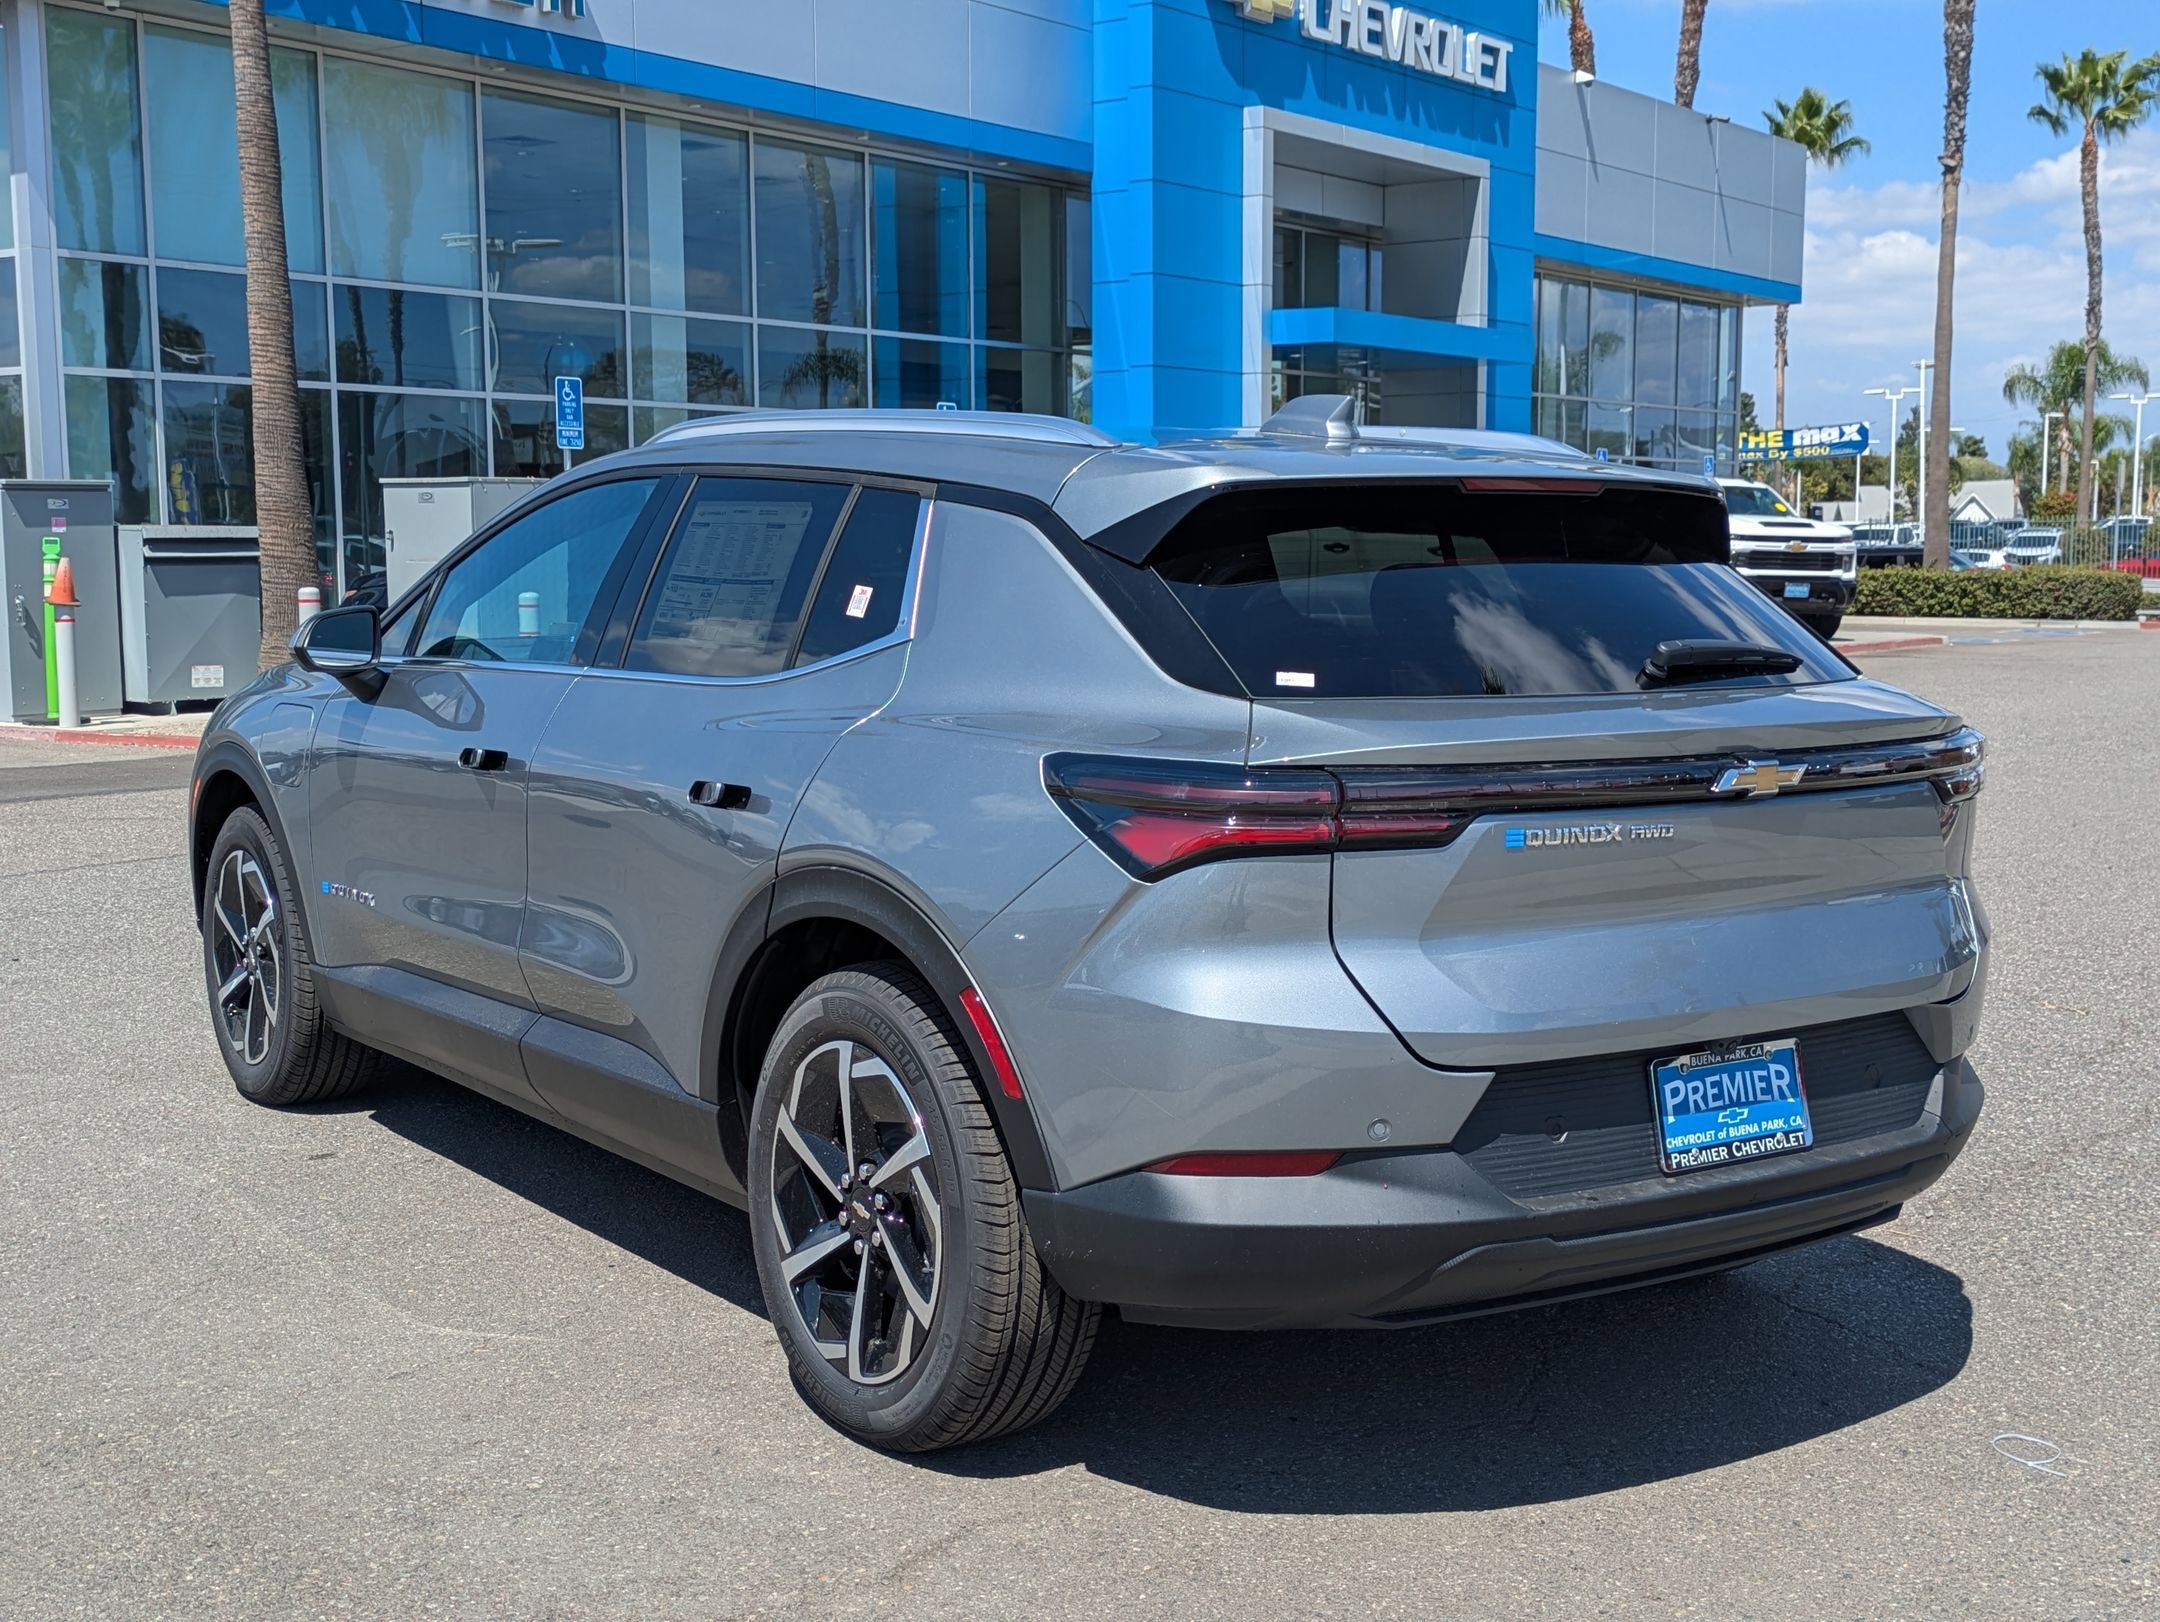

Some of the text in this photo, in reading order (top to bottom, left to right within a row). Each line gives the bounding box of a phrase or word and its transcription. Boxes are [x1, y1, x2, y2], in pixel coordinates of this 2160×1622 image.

[1300, 0, 1513, 92] CHEVROLET
[1505, 822, 1624, 848] EQUINOX
[1749, 1046, 1763, 1057] CA
[1663, 1062, 1796, 1125] PREMIER
[1666, 1130, 1716, 1149] CHEVROLET
[1717, 1127, 1727, 1140] of
[1728, 1122, 1760, 1138] BUENA
[1761, 1117, 1788, 1132] PARK,
[1670, 1132, 1804, 1169] PREMIER CHEVROLET
